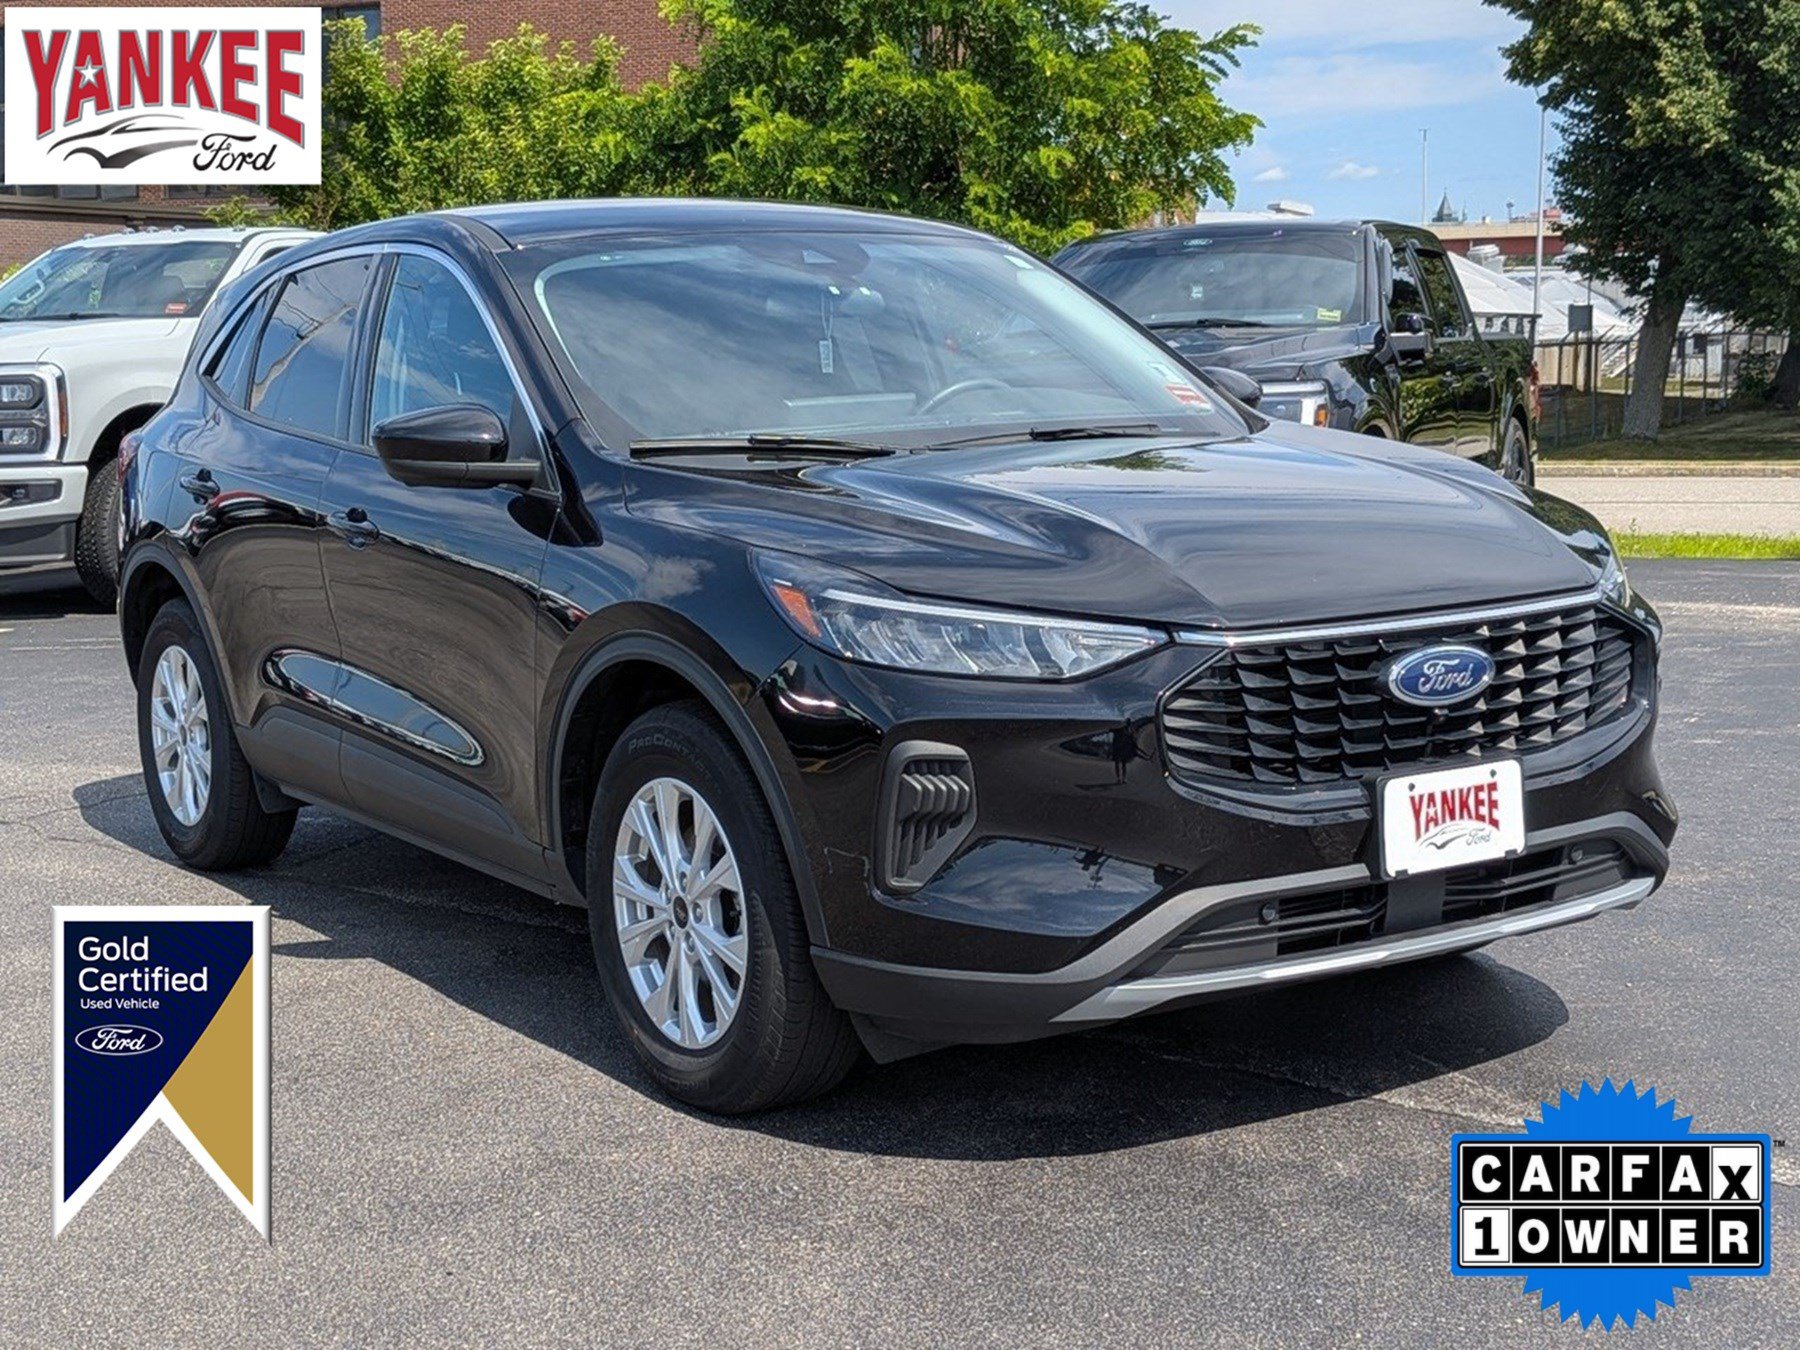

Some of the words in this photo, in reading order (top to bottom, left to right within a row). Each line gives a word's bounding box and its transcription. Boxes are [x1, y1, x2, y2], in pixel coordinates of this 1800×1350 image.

[1418, 658, 1474, 693] Ford
[1409, 781, 1500, 843] YANKEE
[1466, 828, 1494, 846] Ford
